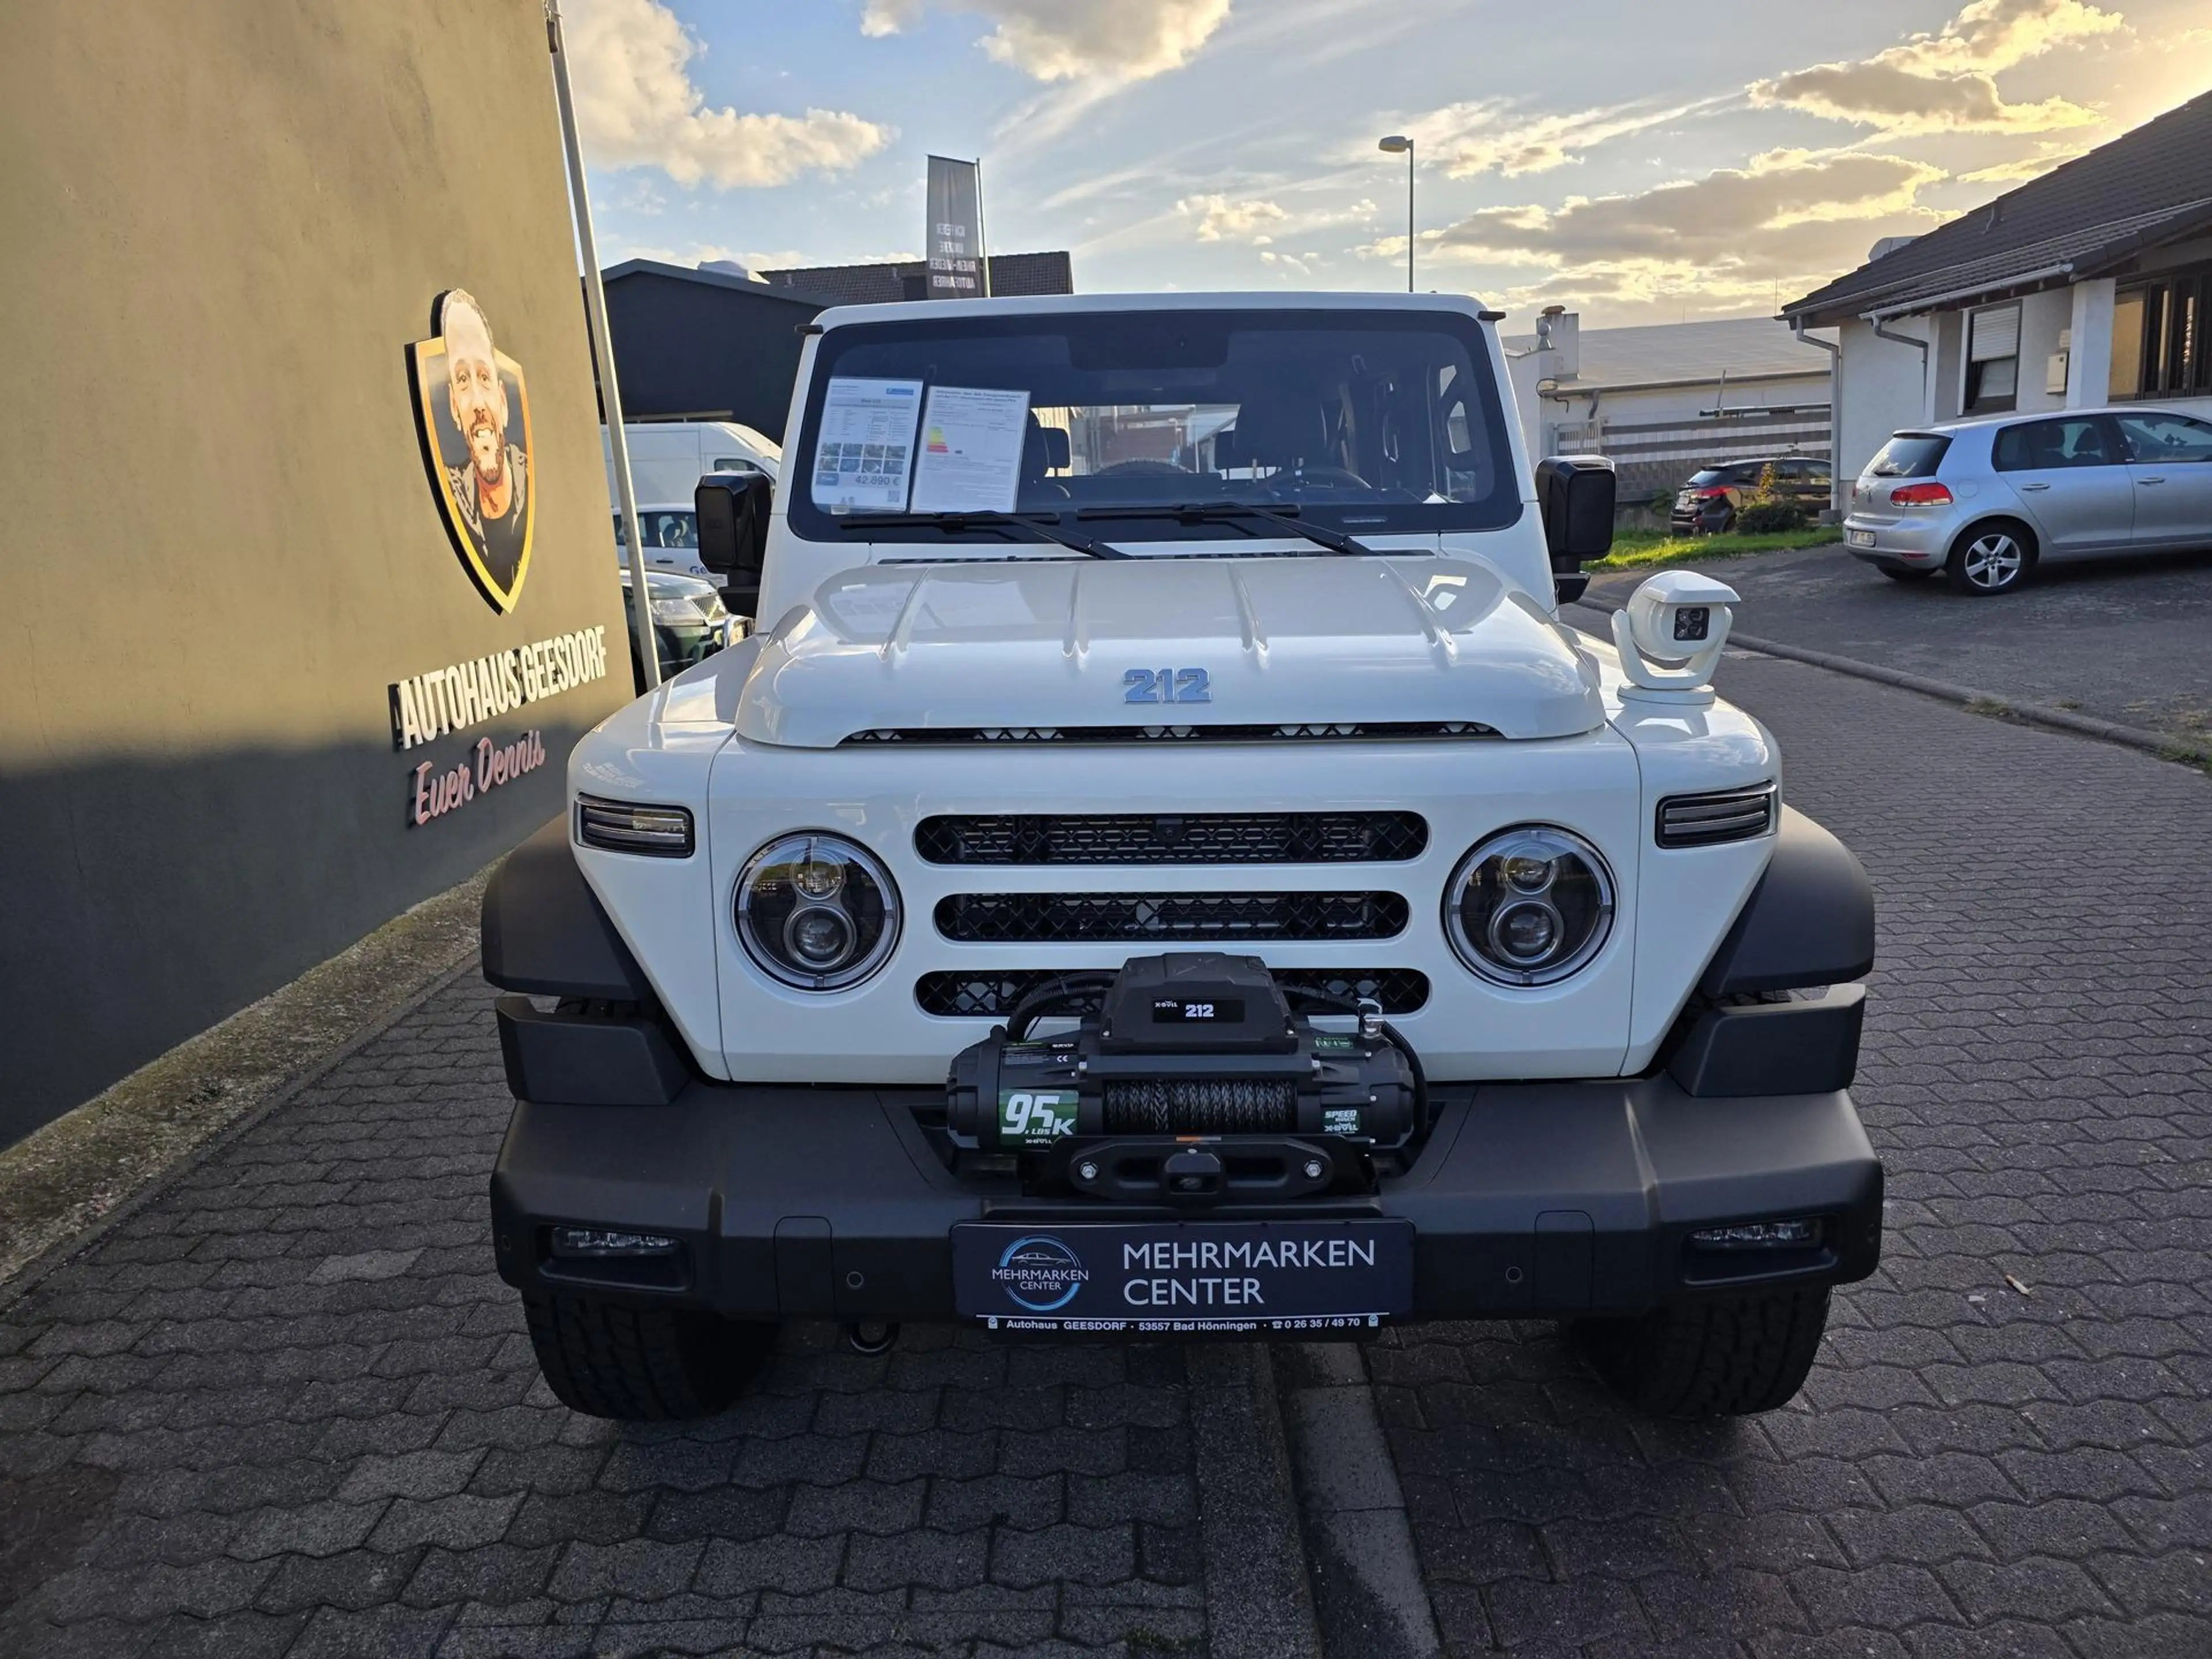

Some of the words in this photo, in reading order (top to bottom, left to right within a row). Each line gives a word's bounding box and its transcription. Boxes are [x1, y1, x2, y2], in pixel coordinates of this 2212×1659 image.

[893, 476, 900, 486] €
[398, 649, 523, 749] AUTOHAUS
[521, 626, 606, 702] GEESDORF
[1124, 667, 1212, 703] 212
[415, 761, 475, 825] Euer
[476, 729, 546, 794] Dennis
[1185, 1004, 1214, 1017] 212
[1325, 1109, 1357, 1118] SPEED
[1123, 1240, 1375, 1269] MEHRMARKEN
[992, 1269, 1089, 1281] MEHRMARKEN
[1020, 1282, 1062, 1290] CENTER
[1123, 1278, 1264, 1305] CENTER
[1007, 1320, 1058, 1330] Autohaus
[1063, 1321, 1127, 1331] GEESDORF
[1173, 1322, 1195, 1330] Bad
[1198, 1321, 1256, 1332] Hönningen
[1347, 1318, 1360, 1326] 70
